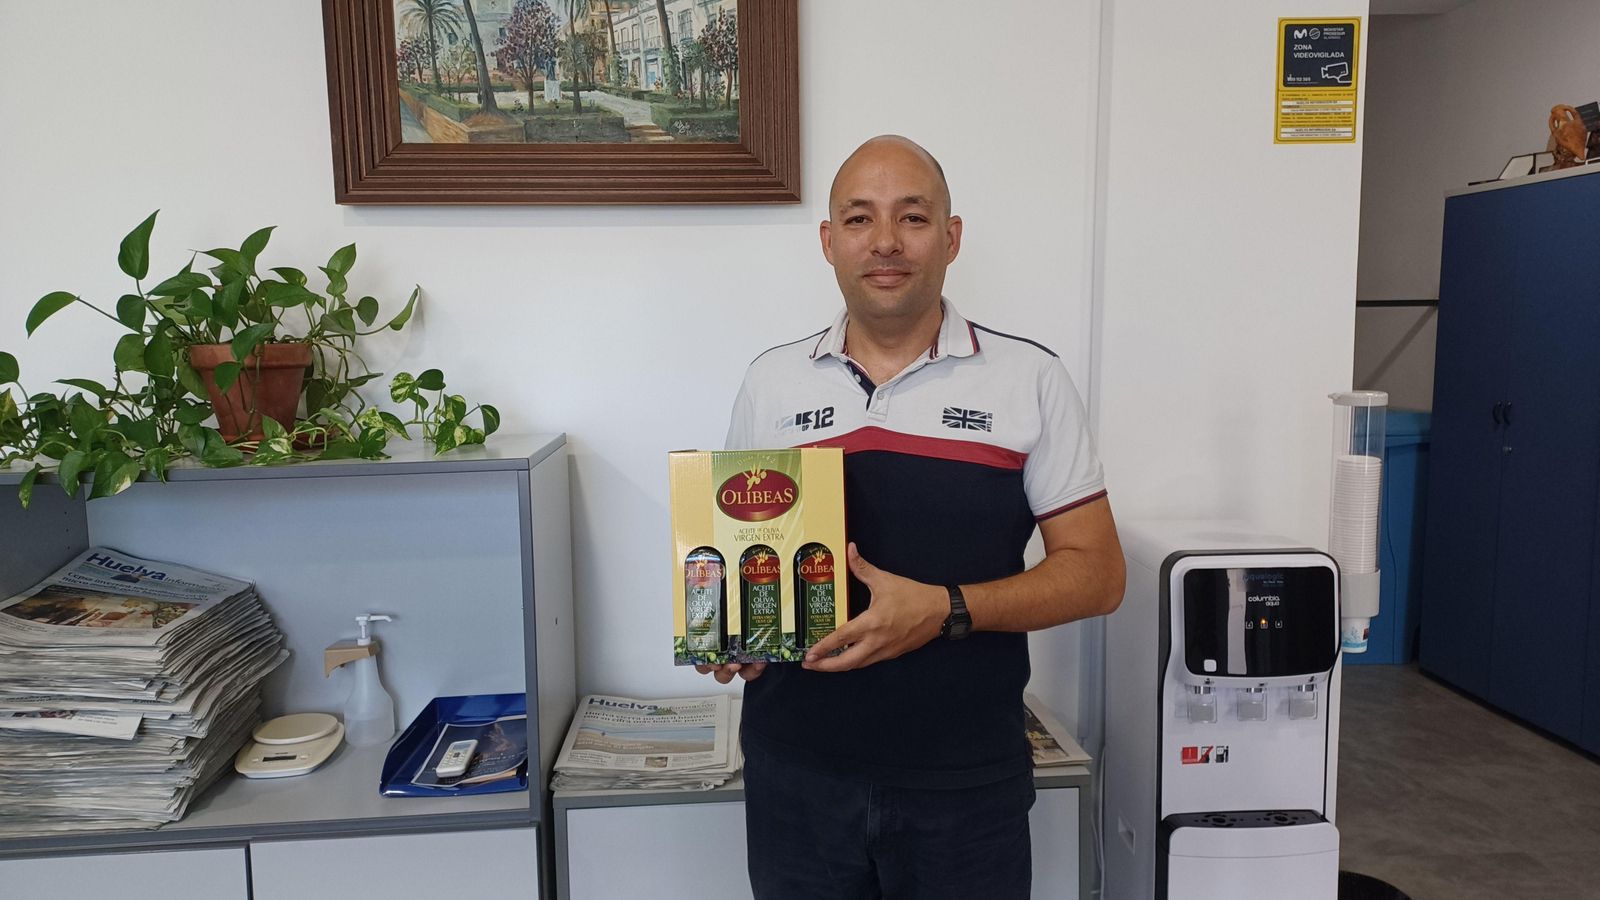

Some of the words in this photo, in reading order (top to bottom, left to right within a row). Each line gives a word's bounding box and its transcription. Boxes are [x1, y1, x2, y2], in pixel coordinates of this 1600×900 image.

[1293, 51, 1345, 59] VIDEOVIGILADA
[721, 487, 794, 505] OLIBEAS
[734, 534, 761, 542] VIRGEN
[762, 533, 785, 541] EXTRA
[86, 552, 166, 581] Huelva
[800, 564, 835, 574] OLIBEA
[1247, 594, 1281, 602] columbia
[588, 697, 658, 711] Huelva
